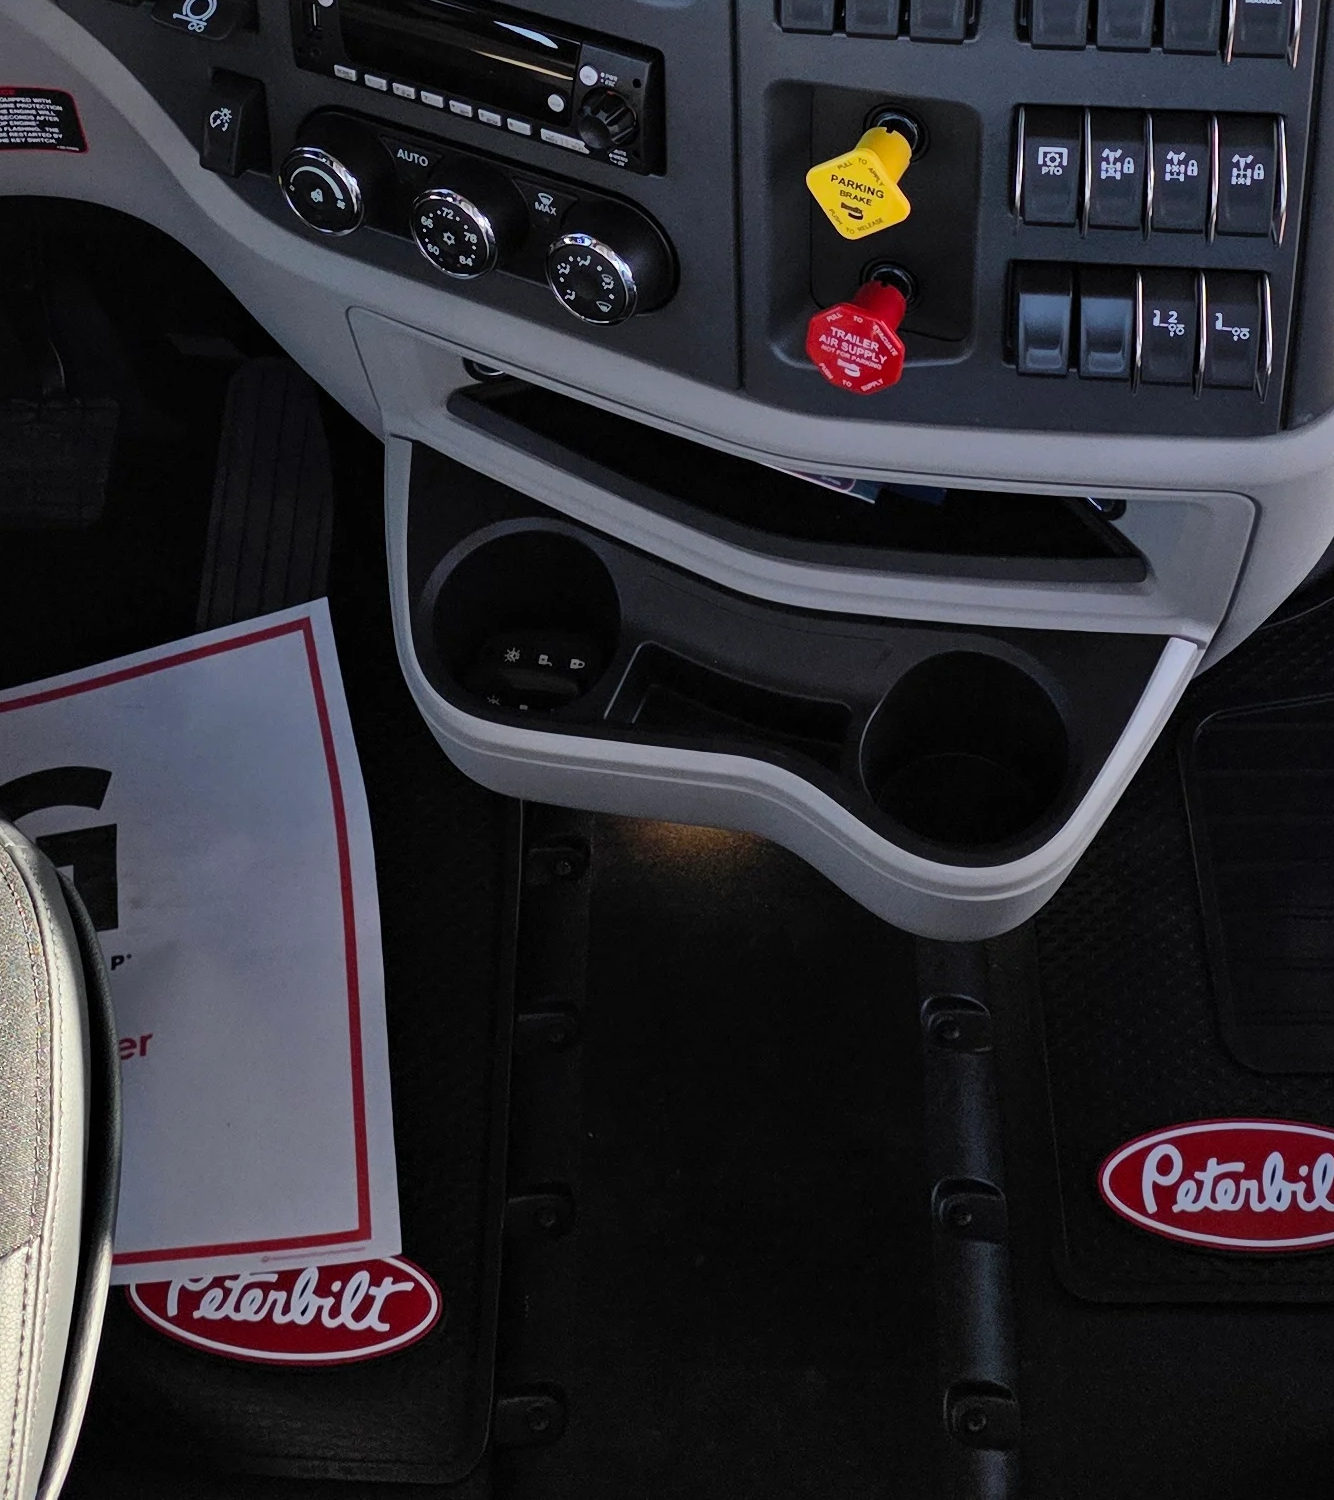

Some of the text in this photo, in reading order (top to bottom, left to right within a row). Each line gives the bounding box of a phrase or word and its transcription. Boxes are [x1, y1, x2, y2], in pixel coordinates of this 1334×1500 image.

[16, 103, 63, 111] PROTECTION
[397, 149, 428, 167] AUTO
[837, 161, 853, 170] PULL
[868, 167, 884, 186] APPLY
[1041, 167, 1062, 175] PTO
[830, 174, 884, 199] PARKING
[839, 189, 872, 206] BRAKE
[441, 206, 454, 220] 72
[534, 201, 556, 216] MAX
[420, 216, 433, 228] 66
[829, 208, 843, 225] PUSH
[857, 217, 884, 232] RELEASE
[463, 232, 477, 243] 78
[427, 244, 439, 255] 60
[459, 255, 473, 267] 84
[826, 312, 899, 357] PULL TO EVACUATE
[830, 326, 879, 352] TRAILER
[818, 334, 887, 365] AIR SUPPLY
[821, 344, 882, 370] NOT FOR PARKING
[819, 363, 883, 392] PUSH TO SUPPLY
[167, 1265, 413, 1333] Peterbilt
